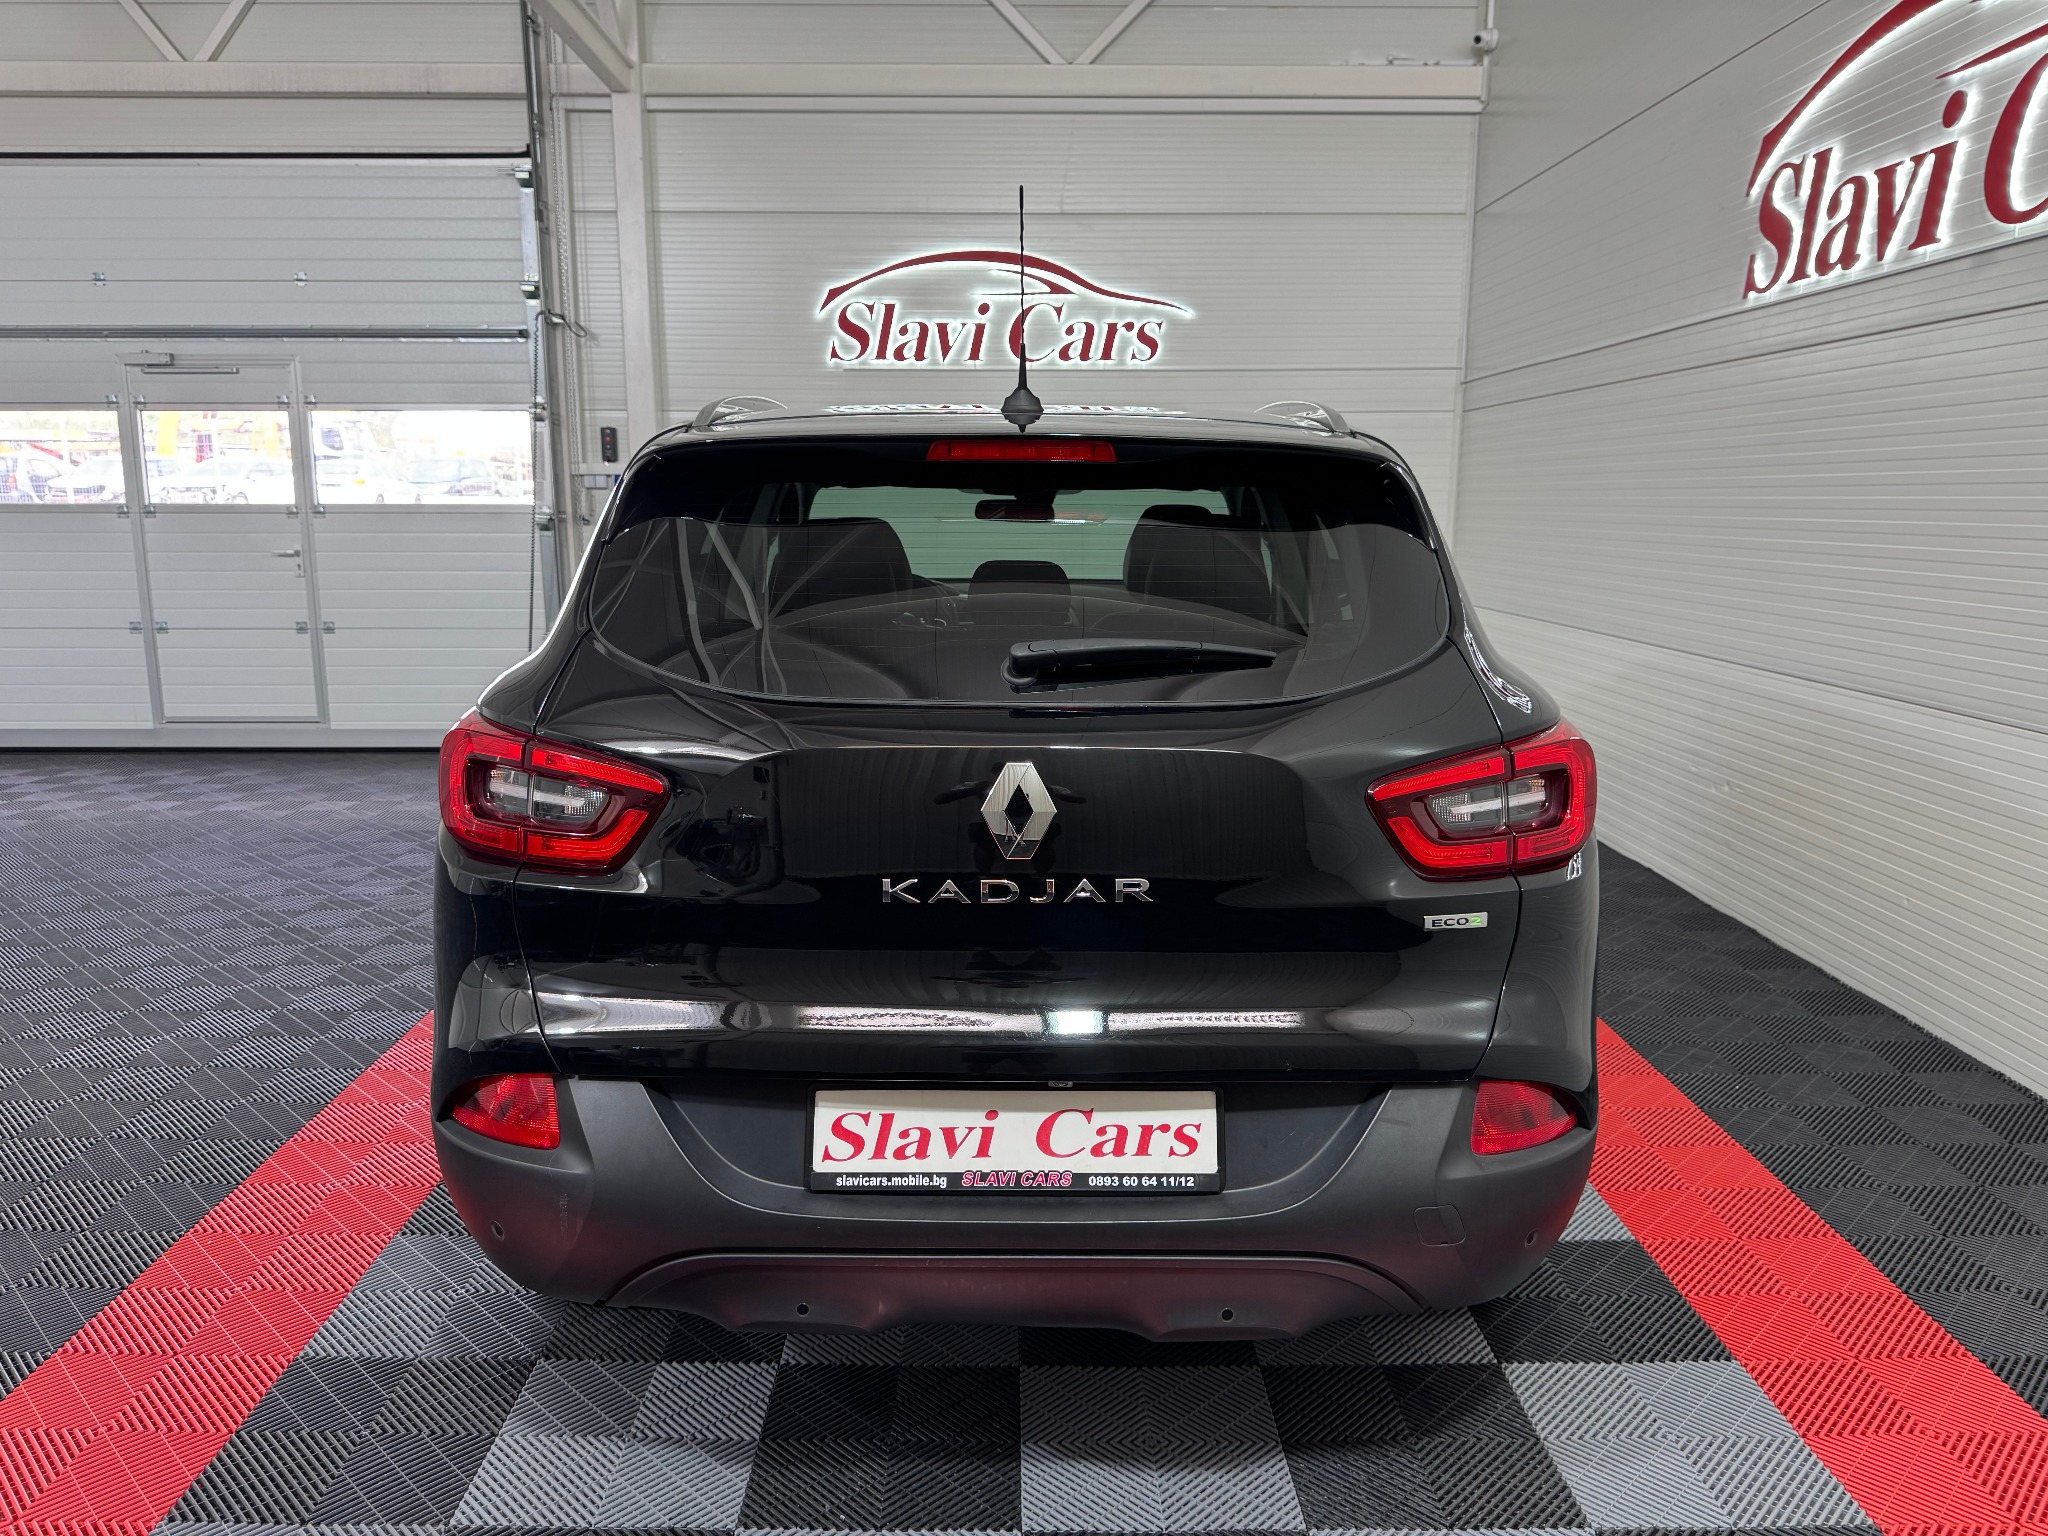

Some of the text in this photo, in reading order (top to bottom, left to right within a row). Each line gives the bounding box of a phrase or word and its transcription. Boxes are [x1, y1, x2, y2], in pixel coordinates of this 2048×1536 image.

[1742, 89, 1969, 300] Slavi
[829, 301, 1165, 363] Slavi Cars
[881, 878, 1154, 904] KADJAR
[1430, 915, 1483, 928] ECO2
[821, 1107, 1202, 1163] Slavi Cars
[835, 1171, 1195, 1189] slavicars.mobile.bg SLAVI CARS 0893 60 64 11/12
